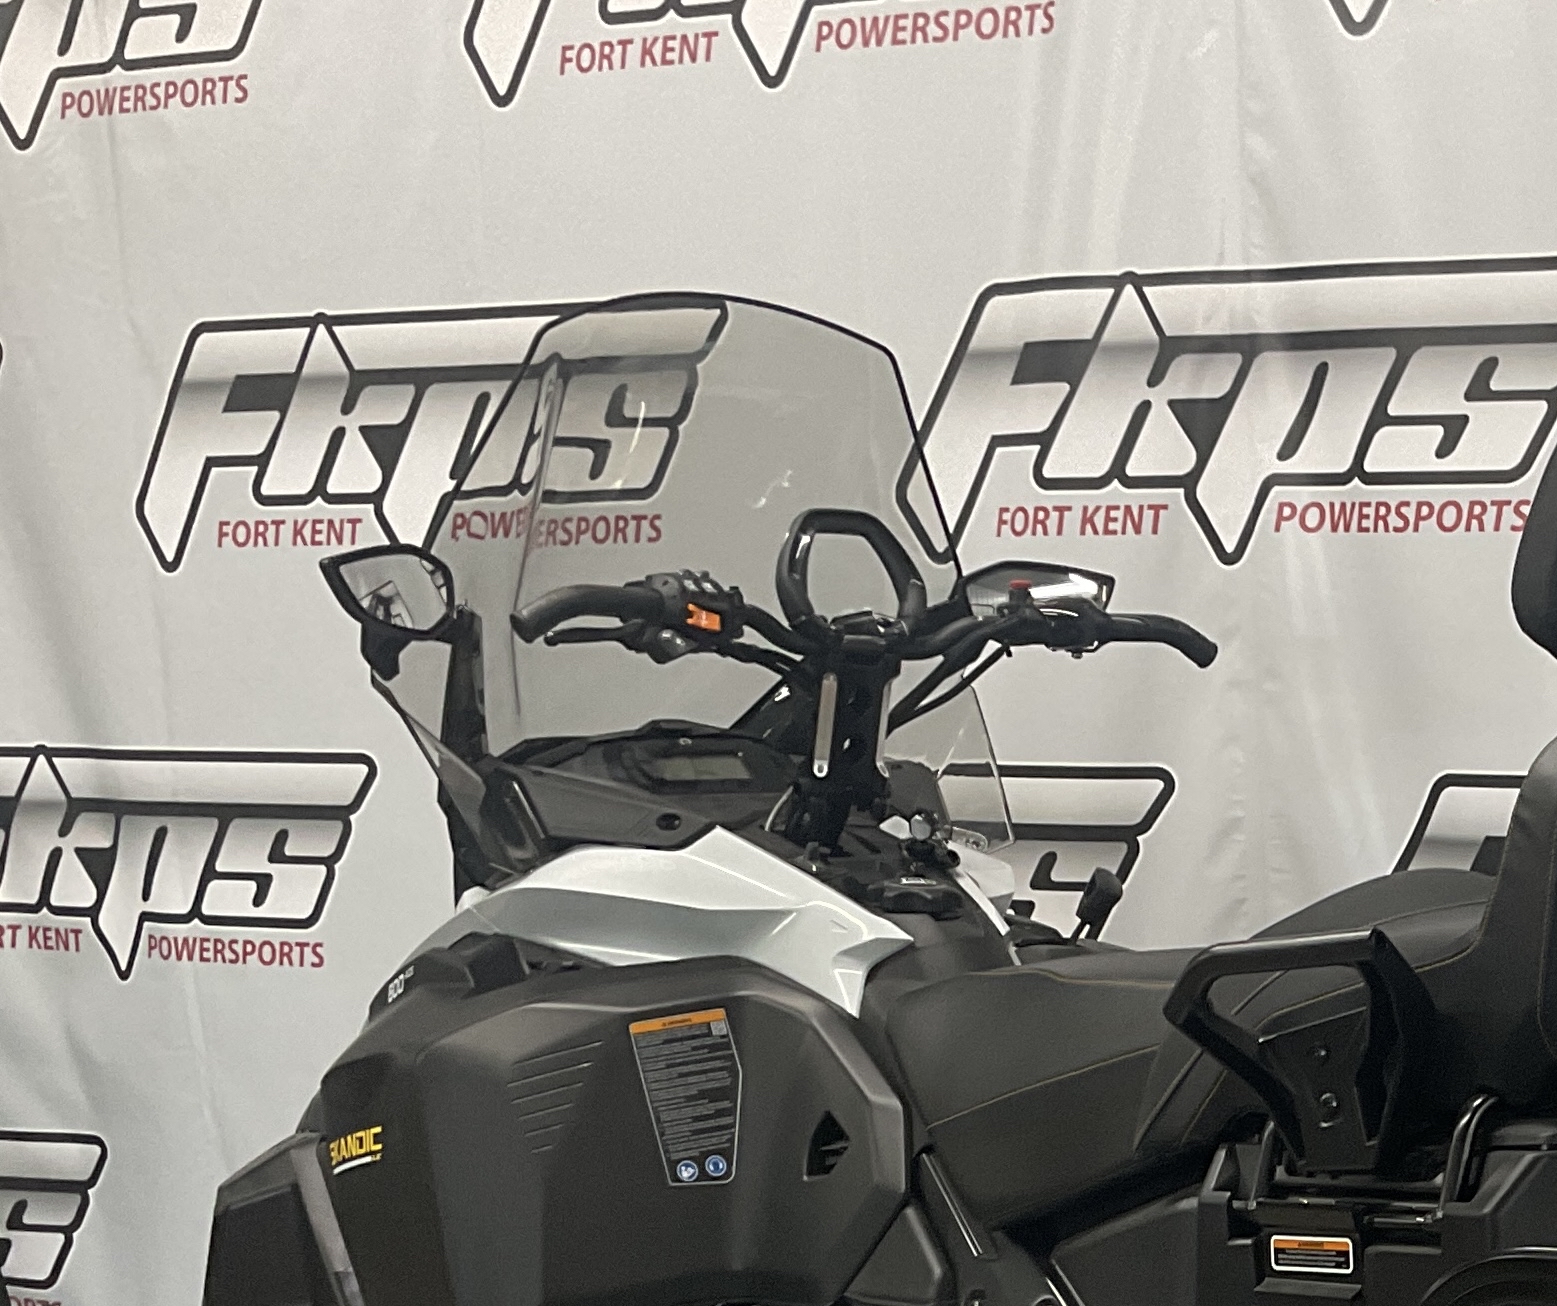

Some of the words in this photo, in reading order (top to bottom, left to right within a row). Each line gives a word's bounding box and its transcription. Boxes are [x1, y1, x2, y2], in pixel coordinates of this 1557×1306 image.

[814, 1, 1057, 52] POWERSPORTS
[559, 38, 635, 75] FORT
[639, 30, 720, 69] KENT
[60, 74, 250, 119] POWERSPORTS
[216, 519, 287, 549] FORT
[290, 517, 363, 547] KENT
[995, 504, 1074, 538] FORT
[1078, 503, 1169, 537] KENT
[1273, 498, 1532, 534] POWERSPORTS
[27, 925, 83, 952] KENT
[147, 933, 326, 968] POWERSPORTS
